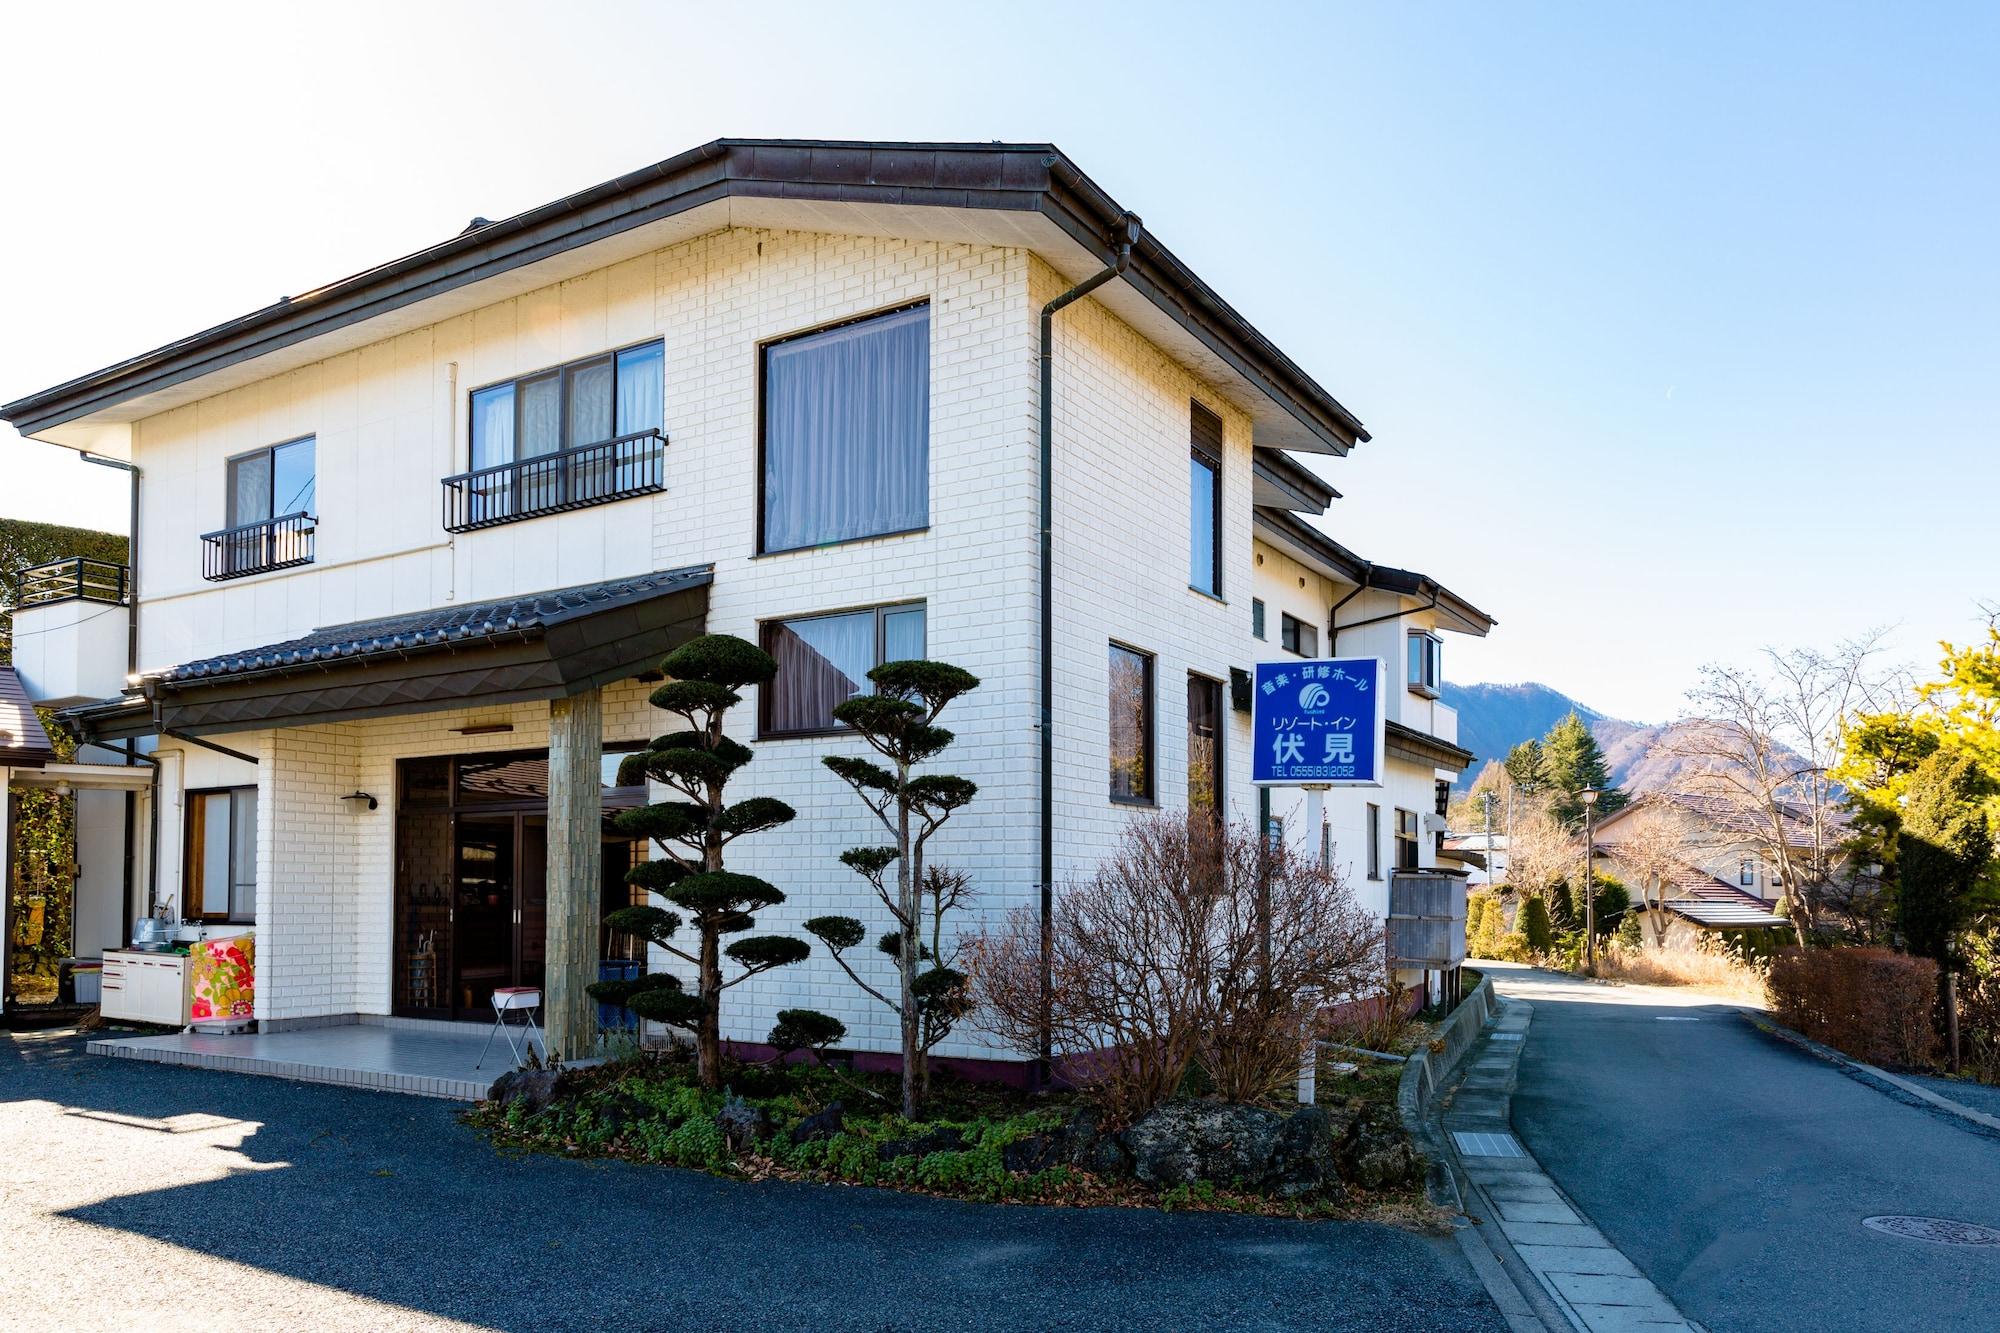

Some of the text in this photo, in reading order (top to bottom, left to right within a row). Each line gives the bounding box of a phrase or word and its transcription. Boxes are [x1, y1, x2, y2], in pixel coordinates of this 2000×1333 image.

[1272, 733, 1355, 764] 伏見
[1272, 766, 1355, 777] TEL 0555(83)2052
